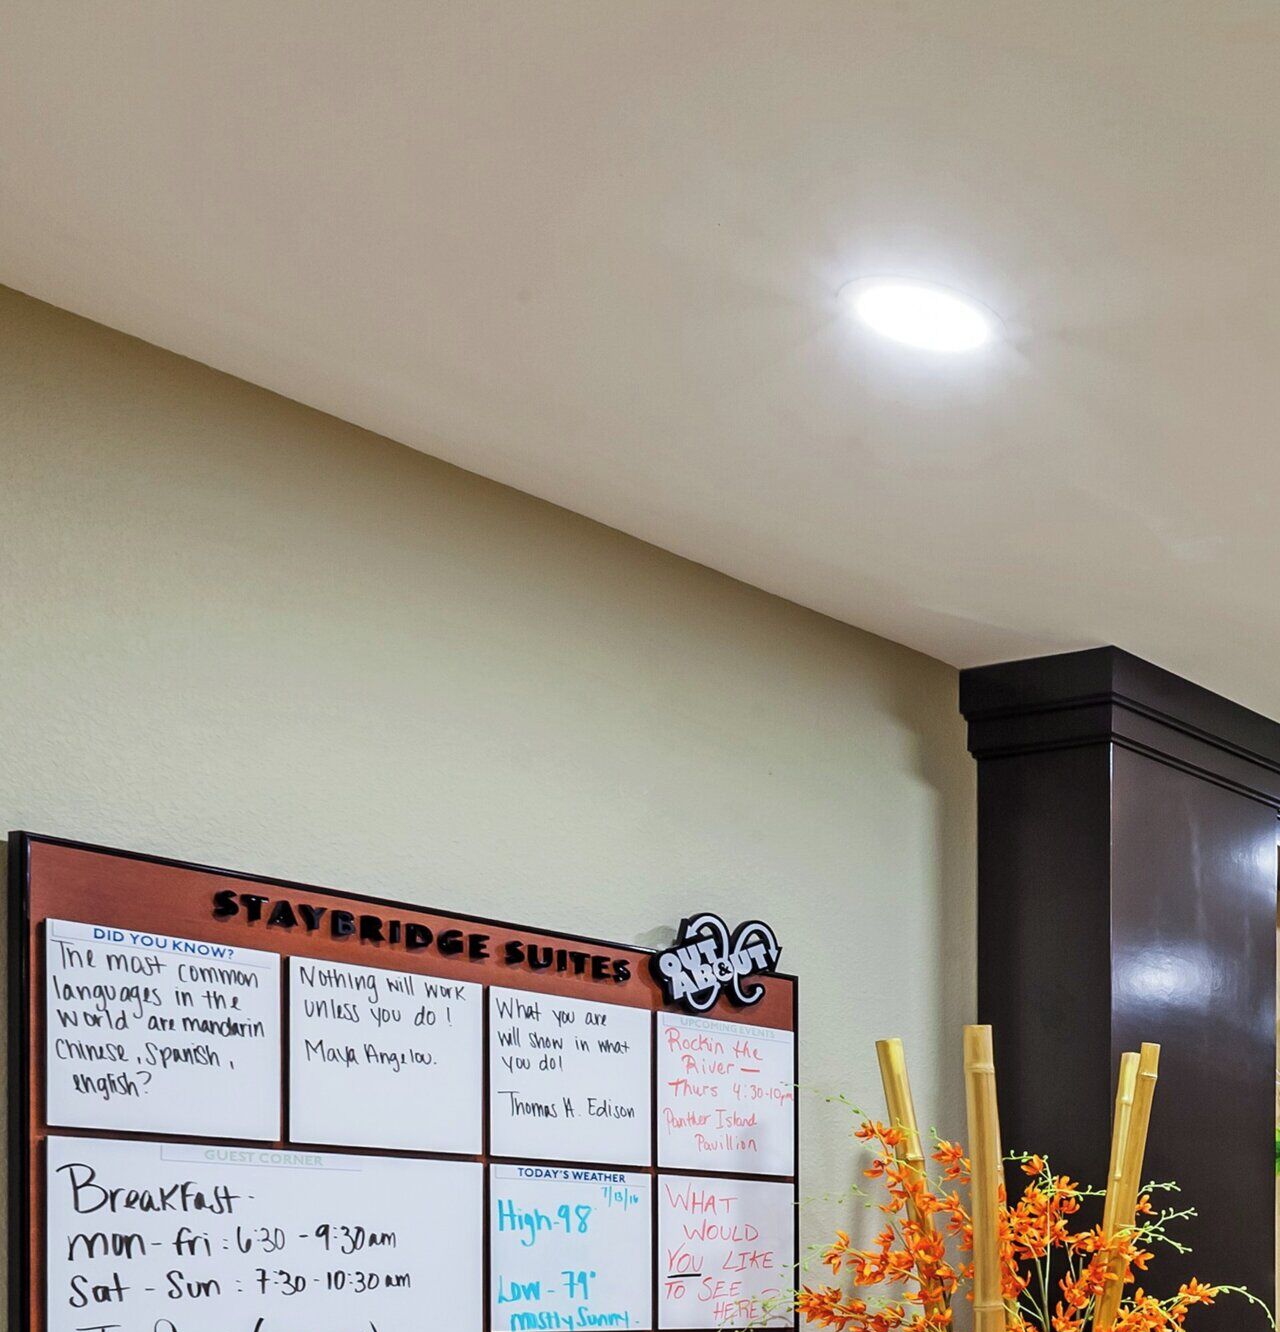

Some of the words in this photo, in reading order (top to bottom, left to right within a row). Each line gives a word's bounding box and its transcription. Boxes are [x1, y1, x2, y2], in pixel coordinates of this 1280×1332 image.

[94, 928, 124, 943] DID
[130, 933, 168, 949] YOU
[172, 940, 234, 960] KNOW?
[212, 889, 491, 959] STAYBRIDGE
[505, 940, 632, 984] SUITES
[50, 939, 96, 970] The
[178, 963, 259, 988] common
[659, 938, 718, 977] OUT
[53, 975, 162, 1019] languages
[175, 987, 194, 1007] in
[201, 990, 242, 1011] the
[300, 965, 379, 1004] Nothing
[386, 975, 415, 997] will
[147, 1015, 176, 1032] are
[304, 999, 360, 1023] unless
[370, 1006, 402, 1028] you
[496, 997, 542, 1022] What
[551, 1009, 575, 1027] you
[585, 1011, 607, 1027] are
[497, 1026, 521, 1048] will
[528, 1030, 563, 1050] show
[574, 1036, 590, 1053] in
[680, 1017, 738, 1034] UPCOMING
[739, 1024, 776, 1039] EVENTS
[304, 1038, 359, 1068] Maya
[665, 1026, 724, 1055] Rockin
[732, 1039, 763, 1061] the
[681, 1054, 735, 1075] River
[497, 1090, 558, 1119] Thomas
[587, 1097, 636, 1120] Edison
[663, 1107, 711, 1136] Panther
[715, 1108, 757, 1130] Island
[204, 1149, 255, 1164] GUEST
[259, 1152, 324, 1168] CORNER
[517, 1167, 570, 1181] TODAY'S
[571, 1171, 626, 1184] WEATHER
[665, 1182, 738, 1216] WHAT
[683, 1219, 759, 1242] WOULD
[667, 1242, 704, 1274] YOU
[722, 1250, 774, 1273] LIKE
[69, 1271, 132, 1309] Sat
[166, 1269, 221, 1300] Sun
[664, 1280, 686, 1300] TO
[697, 1276, 742, 1302] SEE
